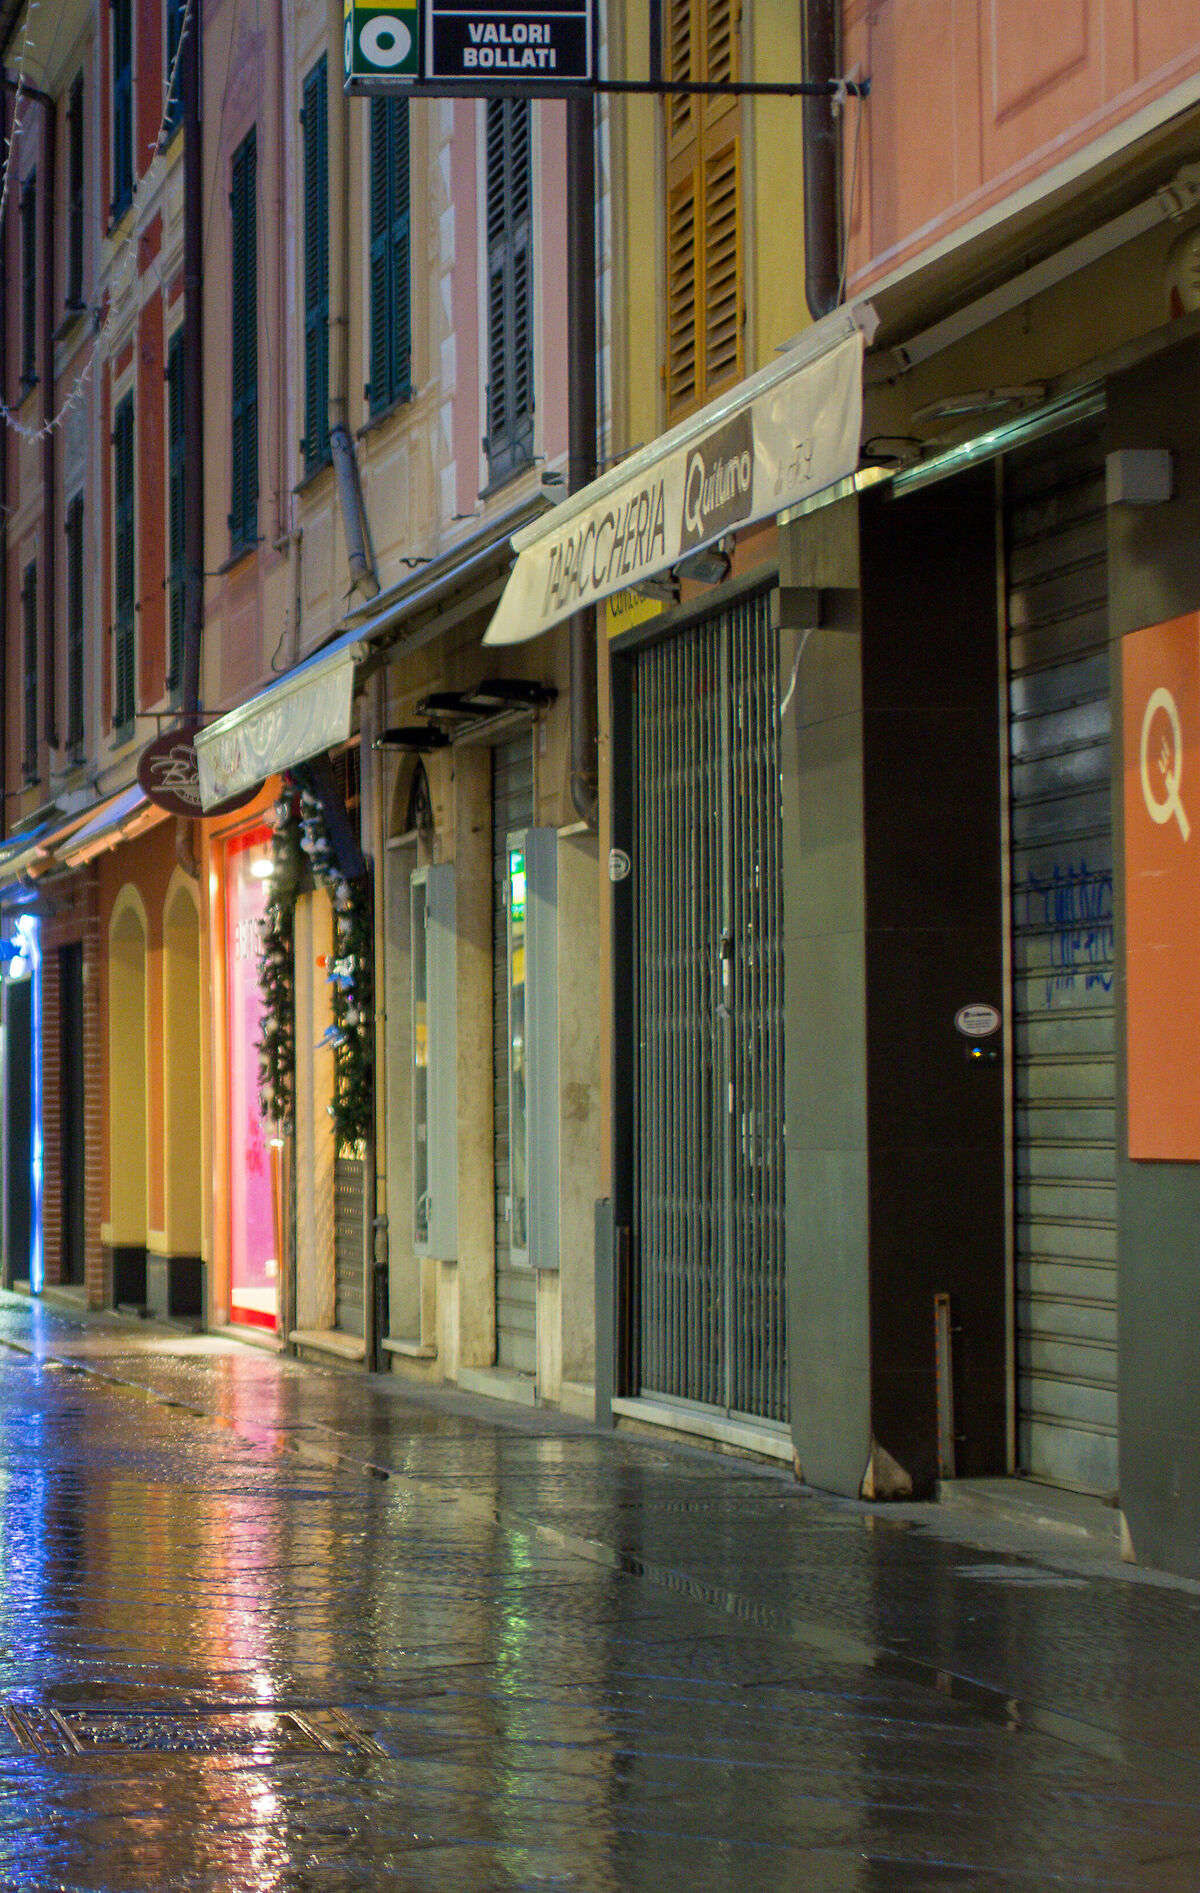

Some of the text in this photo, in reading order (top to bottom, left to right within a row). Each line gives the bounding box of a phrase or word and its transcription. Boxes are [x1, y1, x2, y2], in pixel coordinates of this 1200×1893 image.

[468, 23, 551, 44] VALORI
[463, 47, 557, 68] BOLLATI
[542, 479, 665, 617] TABACCHERIA
